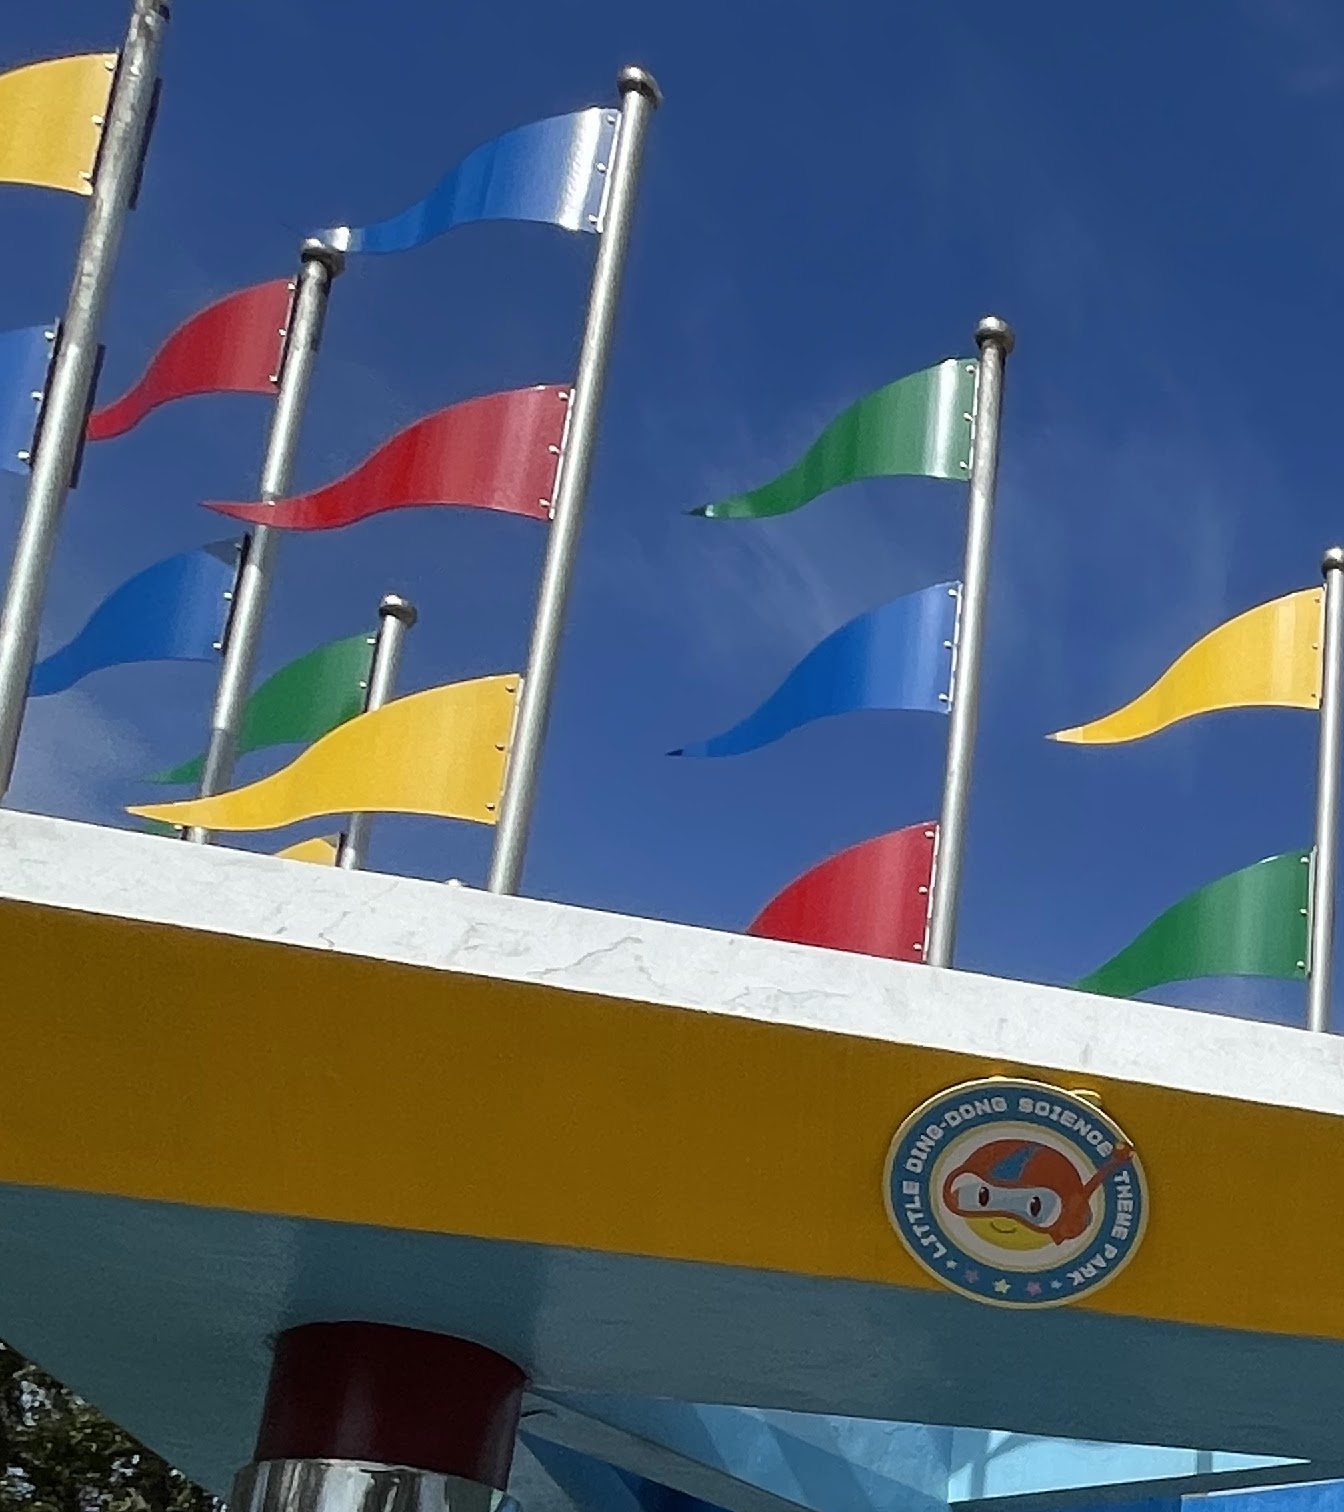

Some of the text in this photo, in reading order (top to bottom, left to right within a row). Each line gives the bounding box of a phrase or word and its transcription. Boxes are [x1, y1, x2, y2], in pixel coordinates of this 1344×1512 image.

[902, 1180, 948, 1260] LITTLE
[1113, 1170, 1134, 1242] THEME
[1066, 1243, 1118, 1286] PARK
